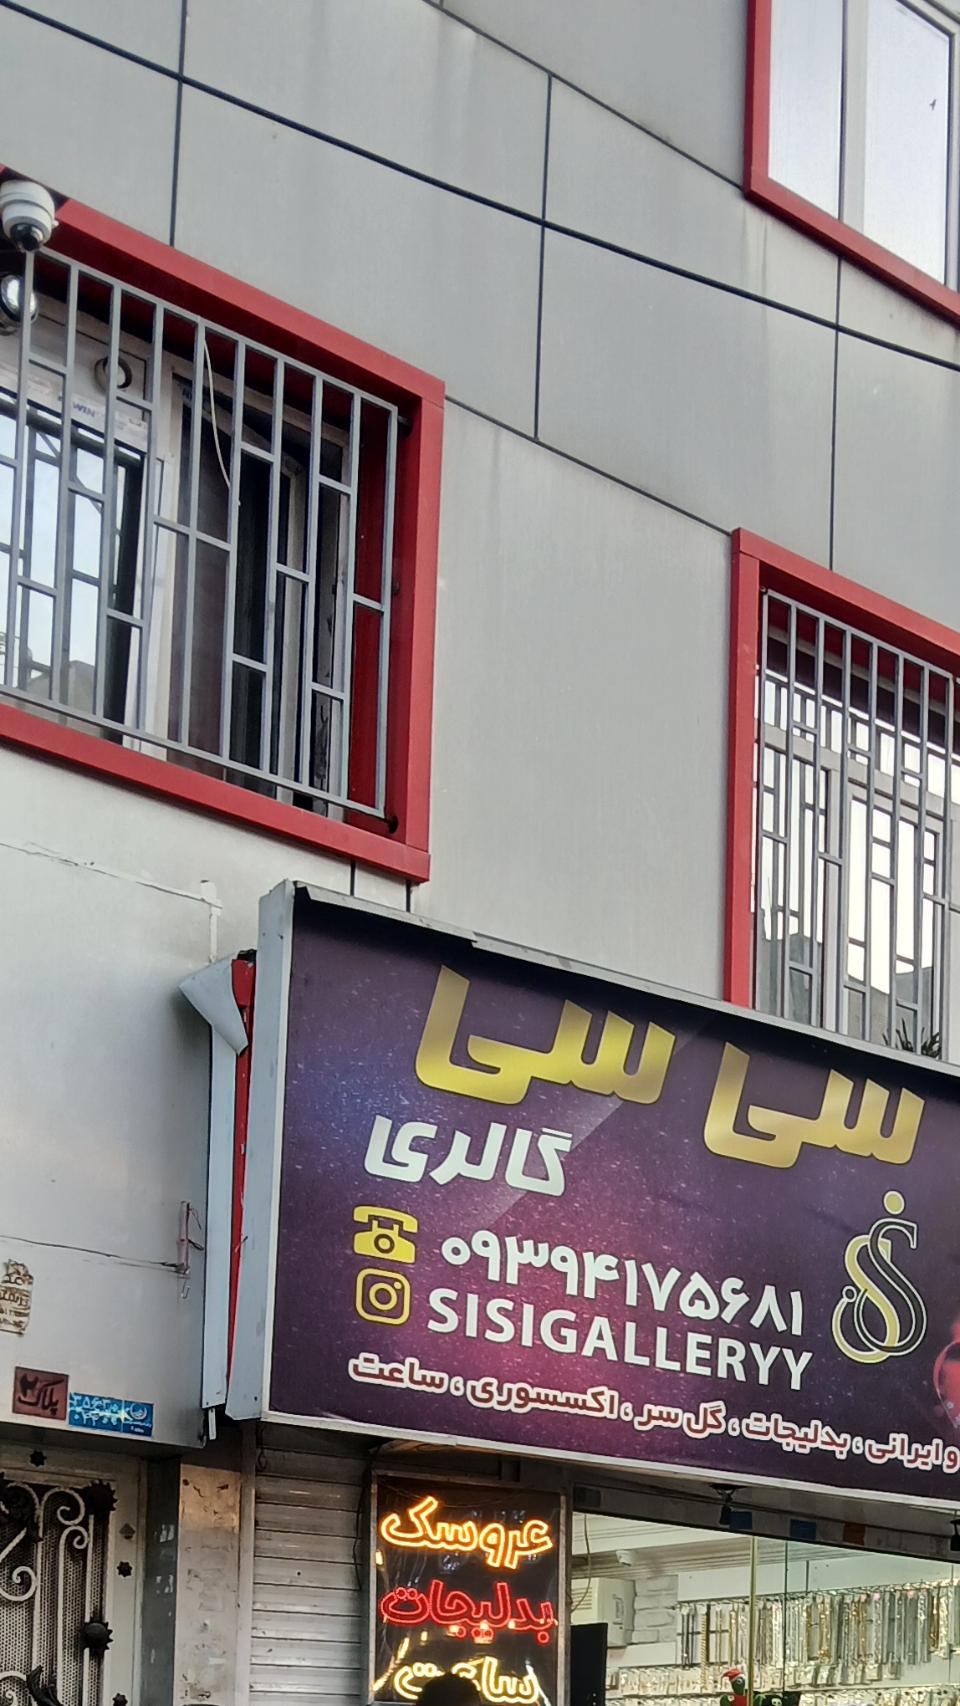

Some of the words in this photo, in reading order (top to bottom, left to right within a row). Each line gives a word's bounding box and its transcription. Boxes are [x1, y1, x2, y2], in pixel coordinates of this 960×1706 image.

[364, 1114, 573, 1197] گالری
[441, 1229, 803, 1336] ۰۹۳۹۴۱۷۵۶۸۱
[427, 1287, 813, 1391] SISIGALLERYY
[348, 1352, 449, 1394] ساعت
[18, 1378, 65, 1416] پلاک
[466, 1377, 619, 1420] اکسسوری
[634, 1402, 684, 1431] سر
[683, 1400, 726, 1438] گل
[742, 1412, 851, 1459] بدلیجات
[865, 1432, 943, 1471] ایرانی
[943, 1447, 960, 1474] و
[380, 1496, 553, 1570] عروسک
[380, 1579, 553, 1644] بدلیجات
